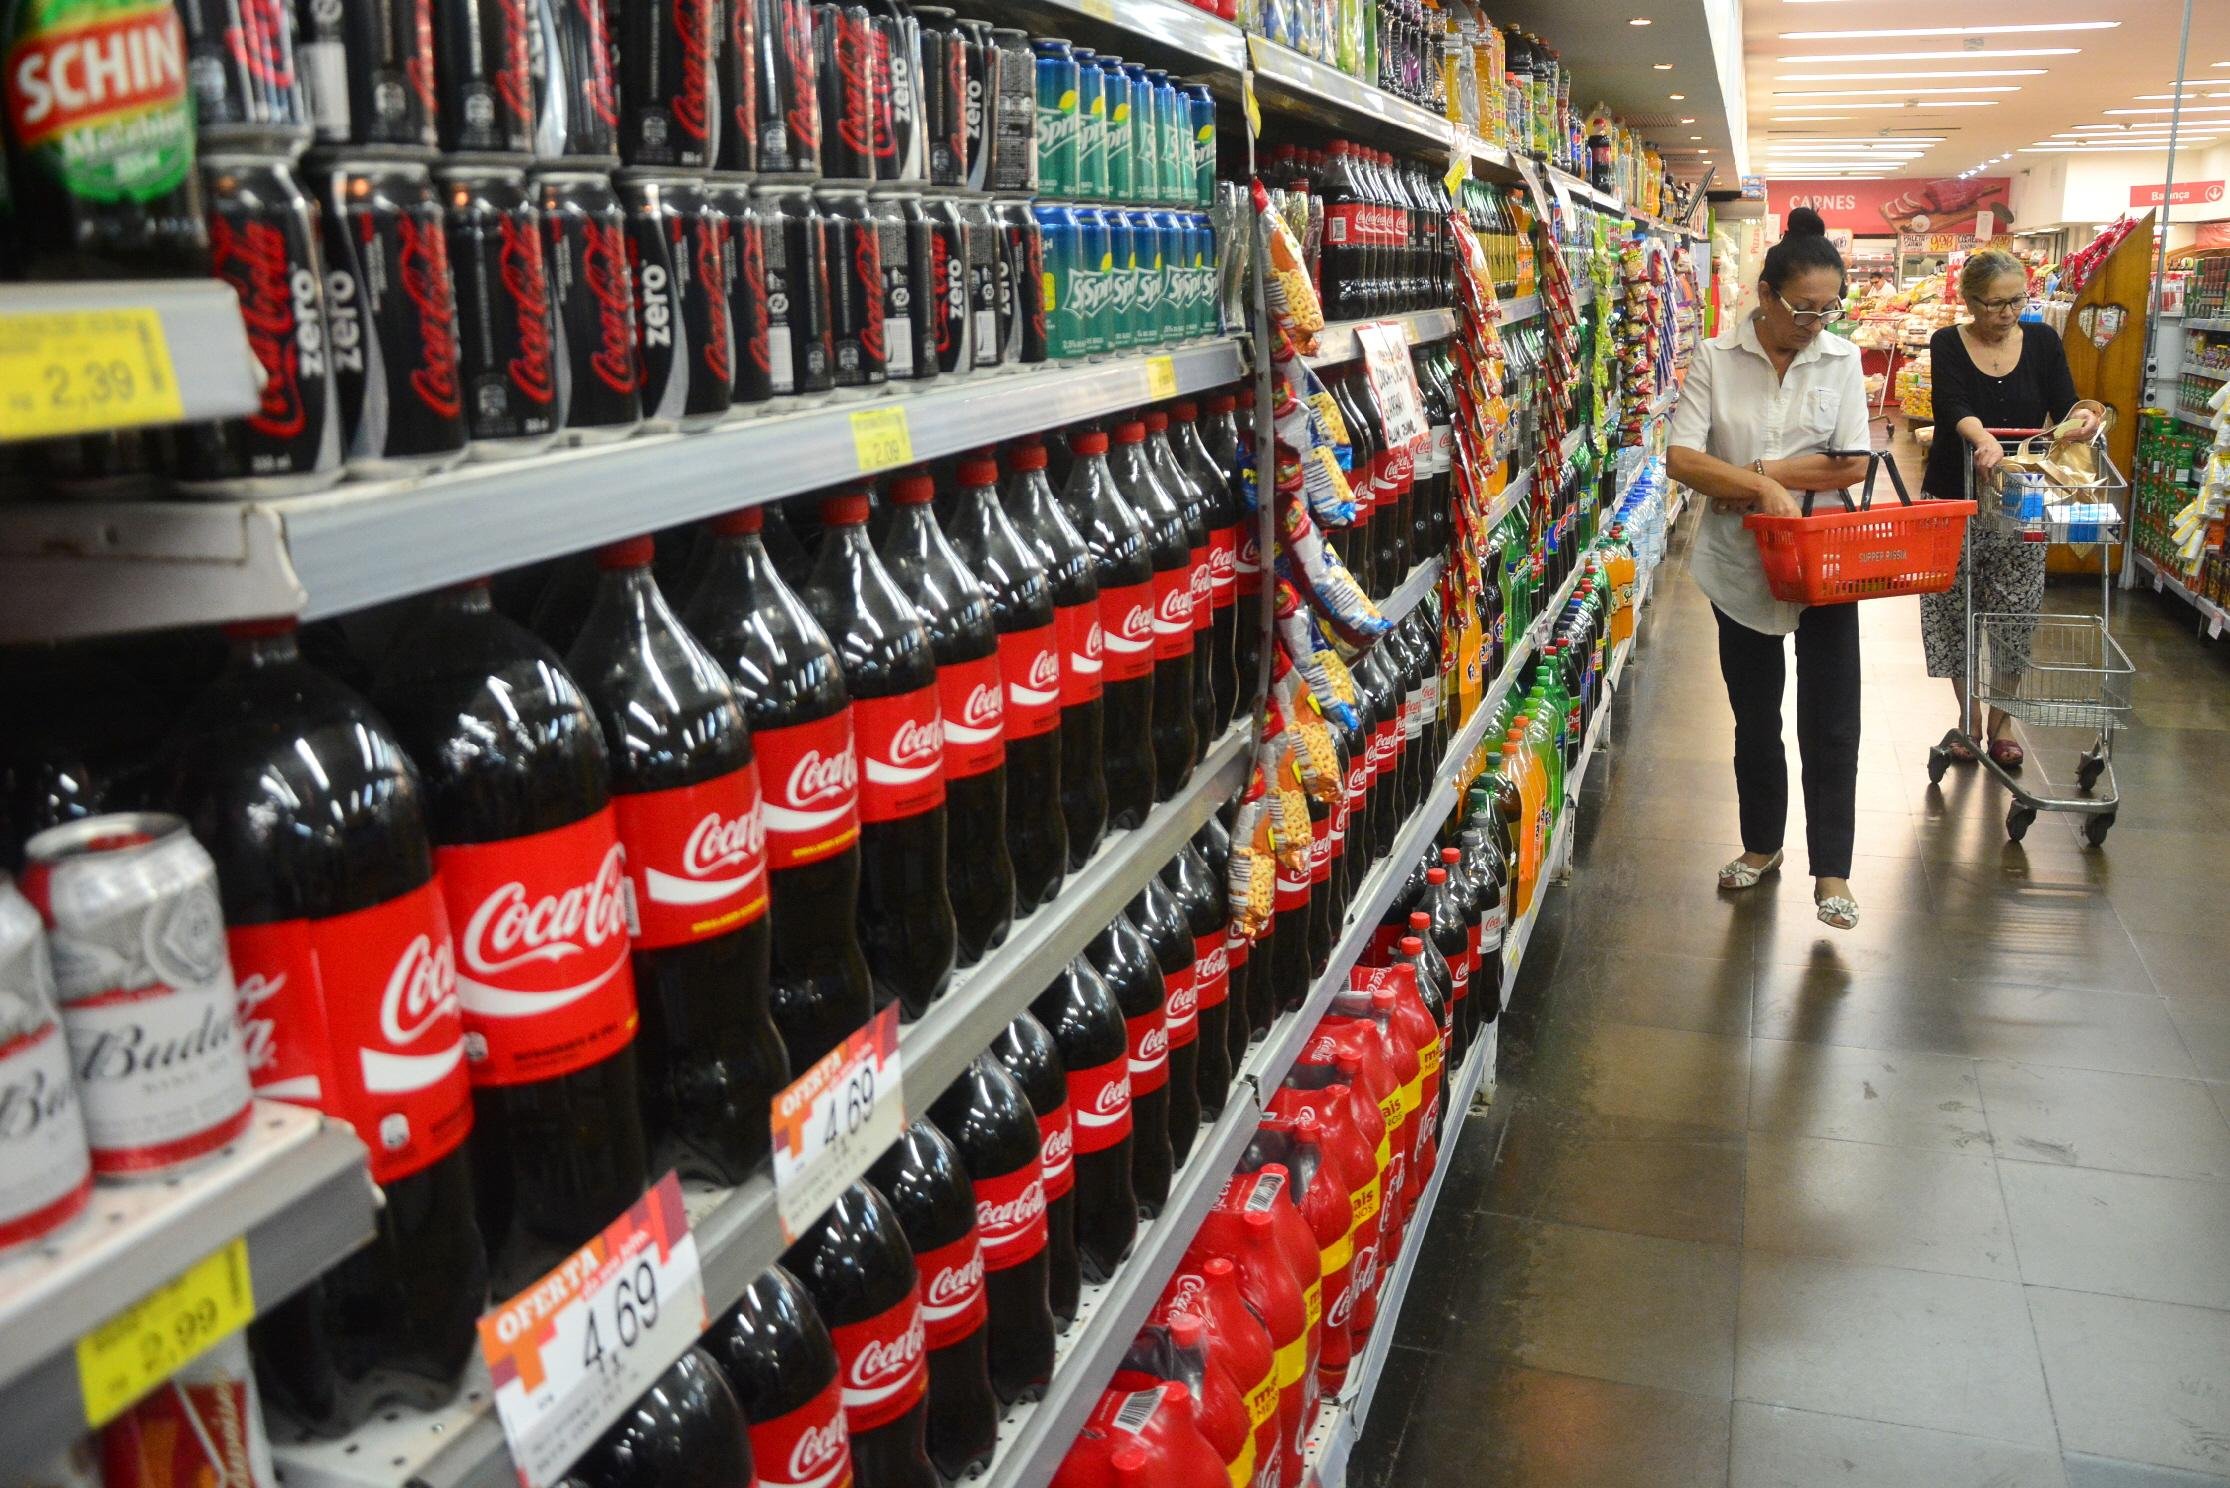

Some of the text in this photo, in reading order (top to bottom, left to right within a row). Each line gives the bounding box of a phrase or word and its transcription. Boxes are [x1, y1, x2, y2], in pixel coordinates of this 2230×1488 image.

[16, 20, 183, 124] SCHIN
[890, 57, 911, 123] zero
[966, 80, 982, 139] zero
[291, 268, 325, 379] zero
[326, 270, 363, 373] zero
[641, 263, 671, 347] zero
[948, 258, 964, 320] zero
[43, 358, 136, 410] 2,39
[824, 1066, 875, 1154] 4,69
[496, 1246, 599, 1343] OFERTA
[582, 1260, 660, 1375] 4,69
